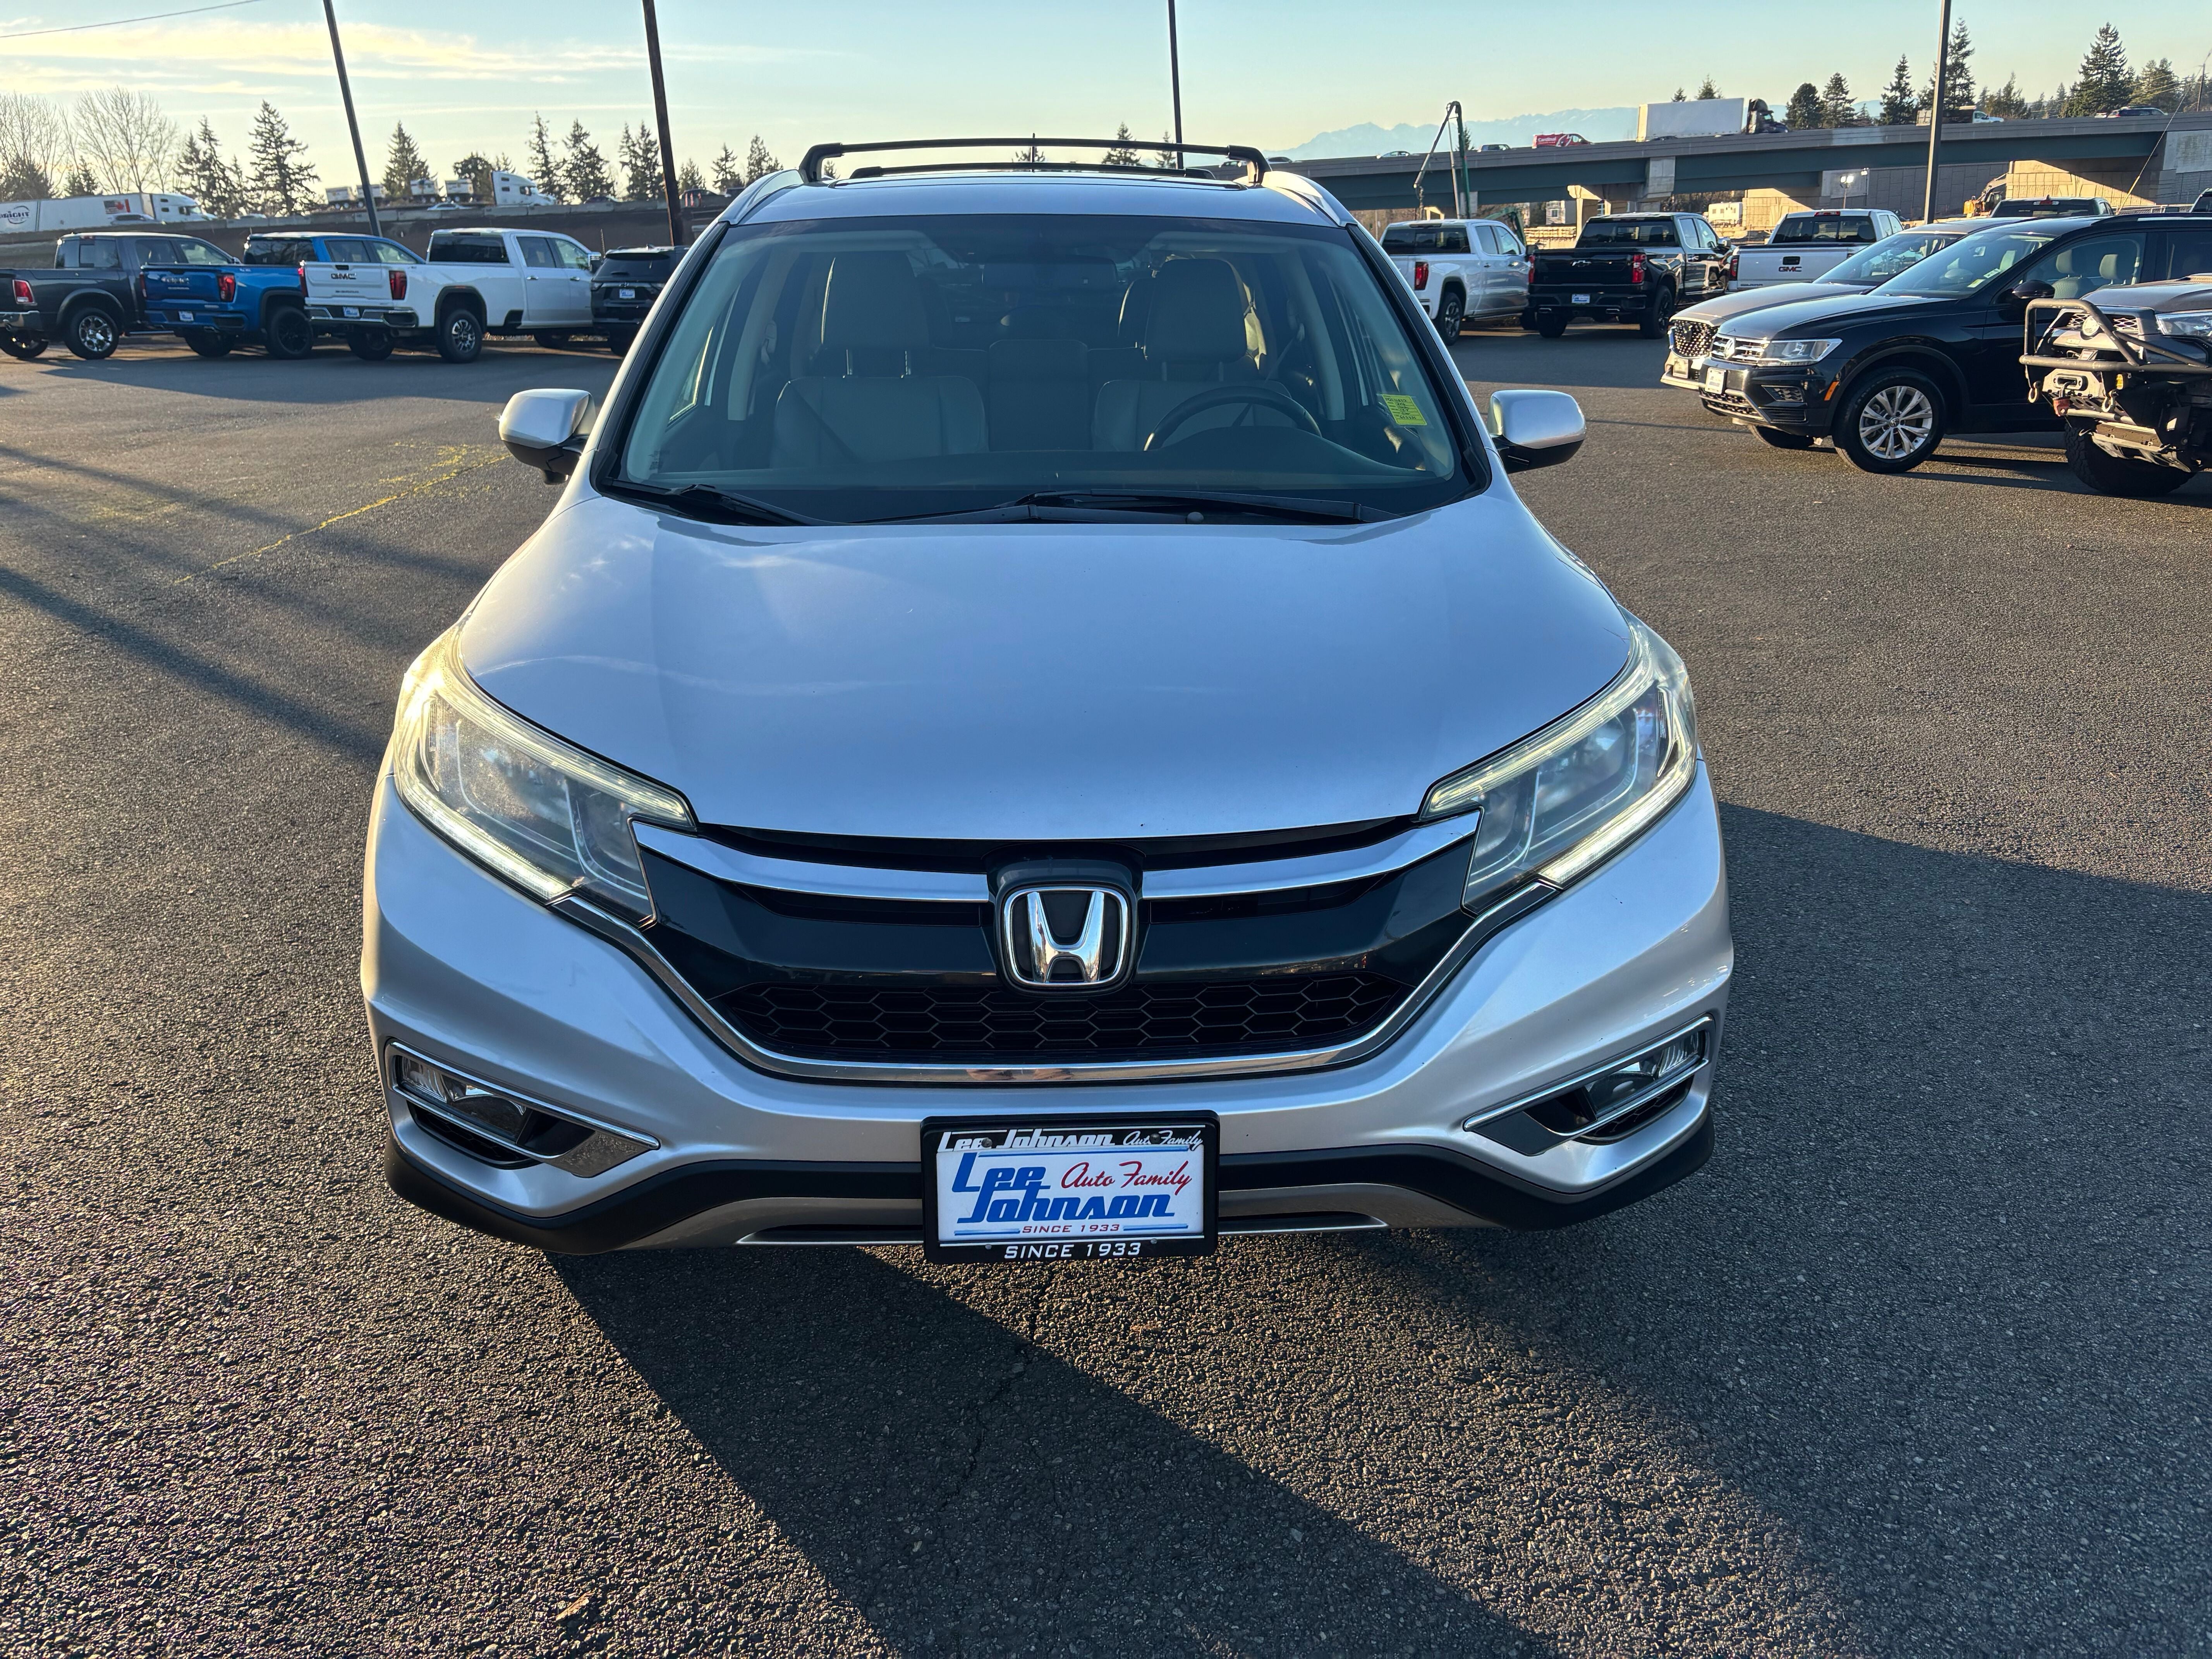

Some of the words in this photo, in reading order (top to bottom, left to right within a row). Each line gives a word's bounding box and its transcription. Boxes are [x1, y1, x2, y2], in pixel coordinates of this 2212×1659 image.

[938, 1132, 991, 1152] Lee
[996, 1128, 1115, 1148] Johnson
[1123, 1131, 1152, 1145] Aut
[1159, 1130, 1202, 1151] Family
[952, 1152, 1051, 1192] Lee
[1061, 1162, 1115, 1188] Auto
[1119, 1161, 1192, 1195] Family
[957, 1179, 1175, 1223] Johnson
[1081, 1224, 1120, 1232] 1933
[1005, 1244, 1074, 1259] SINCE
[1087, 1242, 1141, 1257] 1933
